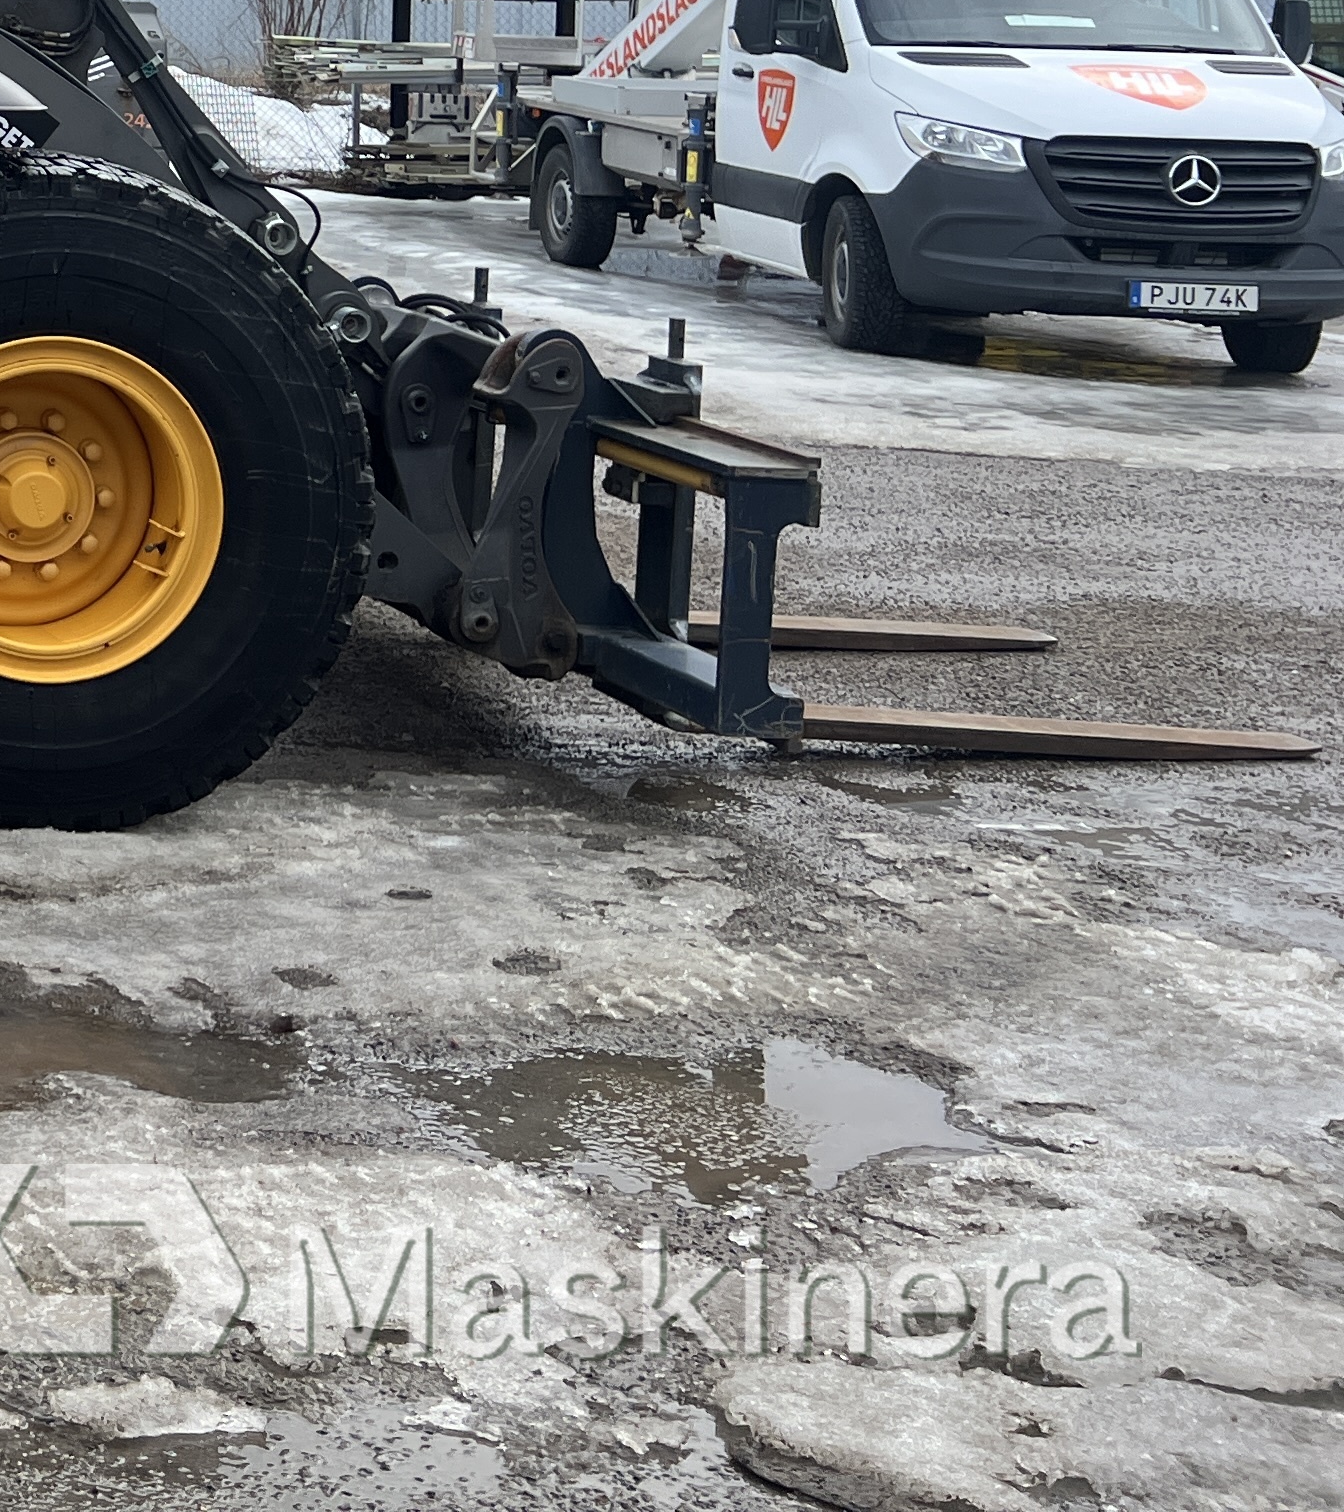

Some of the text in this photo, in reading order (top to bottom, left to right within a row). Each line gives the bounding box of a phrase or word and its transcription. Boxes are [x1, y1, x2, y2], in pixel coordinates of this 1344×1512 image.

[1150, 285, 1248, 308] PJU 74K
[519, 494, 538, 601] VOLVO
